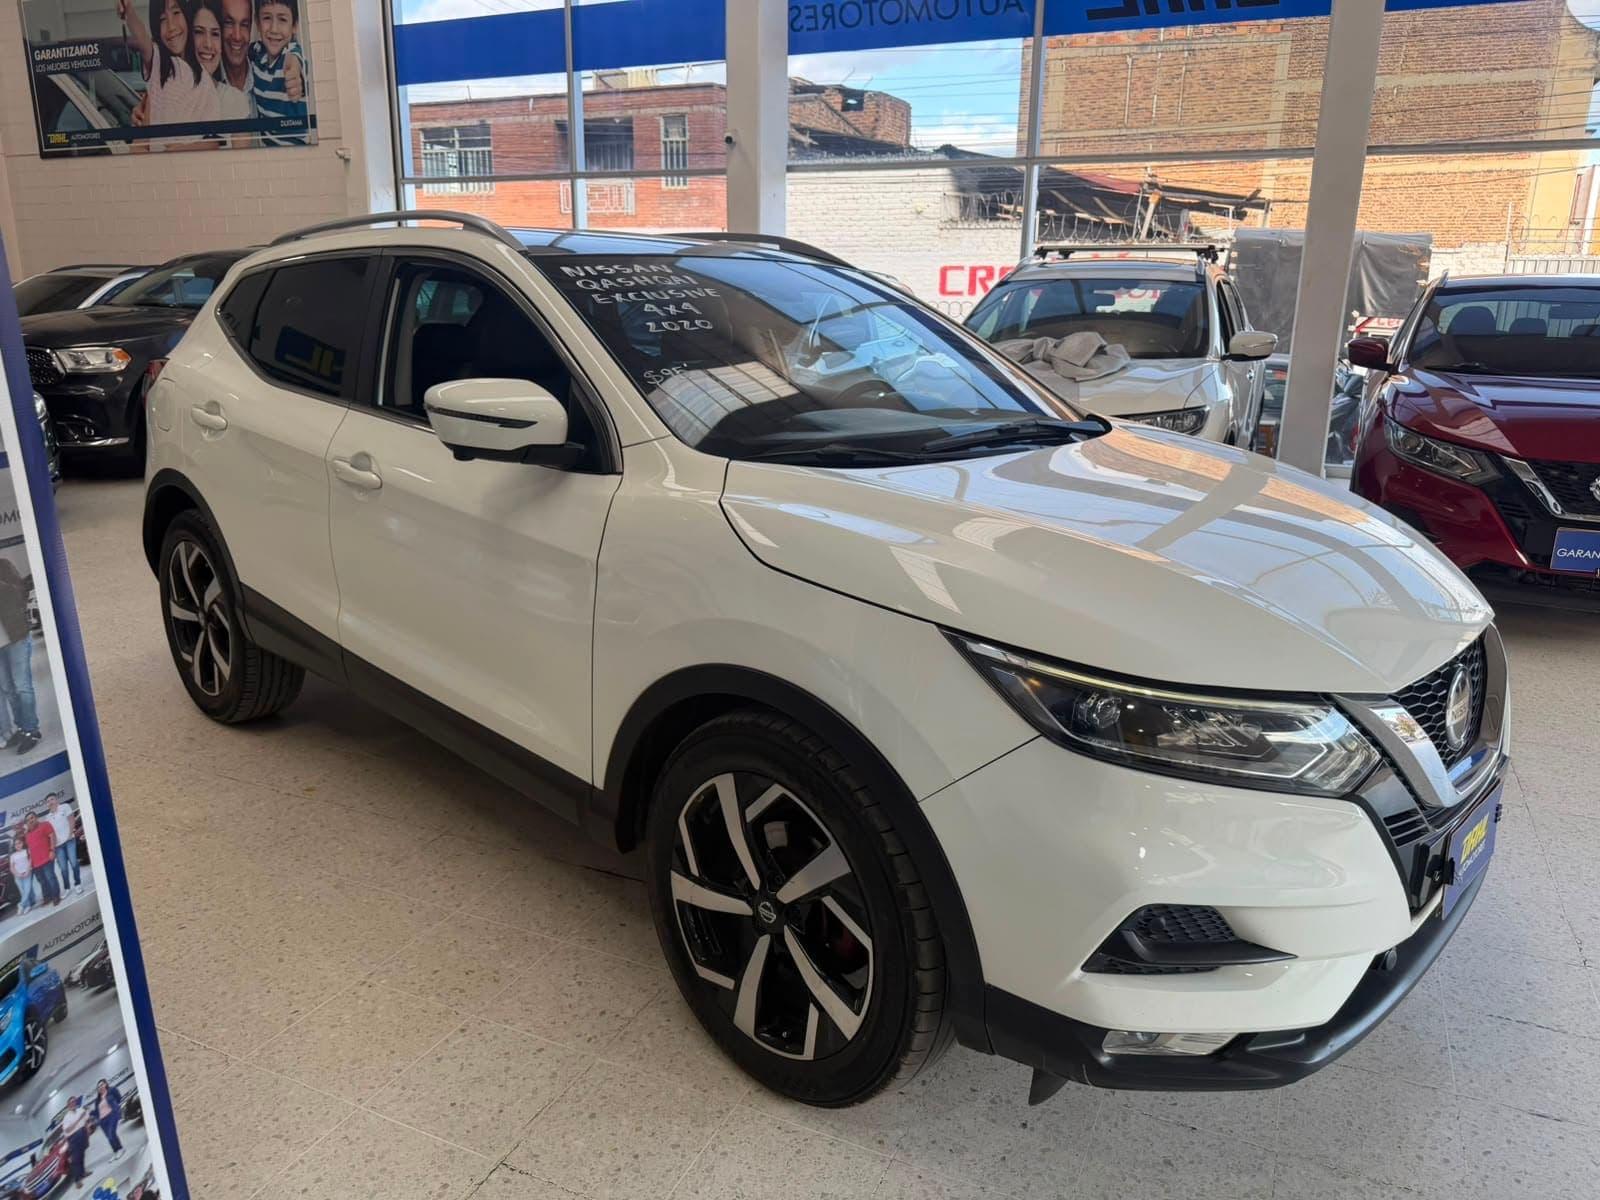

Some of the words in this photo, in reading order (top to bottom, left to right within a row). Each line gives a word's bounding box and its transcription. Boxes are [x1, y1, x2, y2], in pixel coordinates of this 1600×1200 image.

[34, 43, 99, 60] GARANTIZAMOS
[36, 63, 46, 73] LOS
[47, 61, 70, 72] MEJORES
[560, 264, 673, 278] NISSAN
[576, 275, 698, 292] QASHQAI
[592, 288, 720, 304] EXCLUSIVE
[646, 320, 713, 333] 2020
